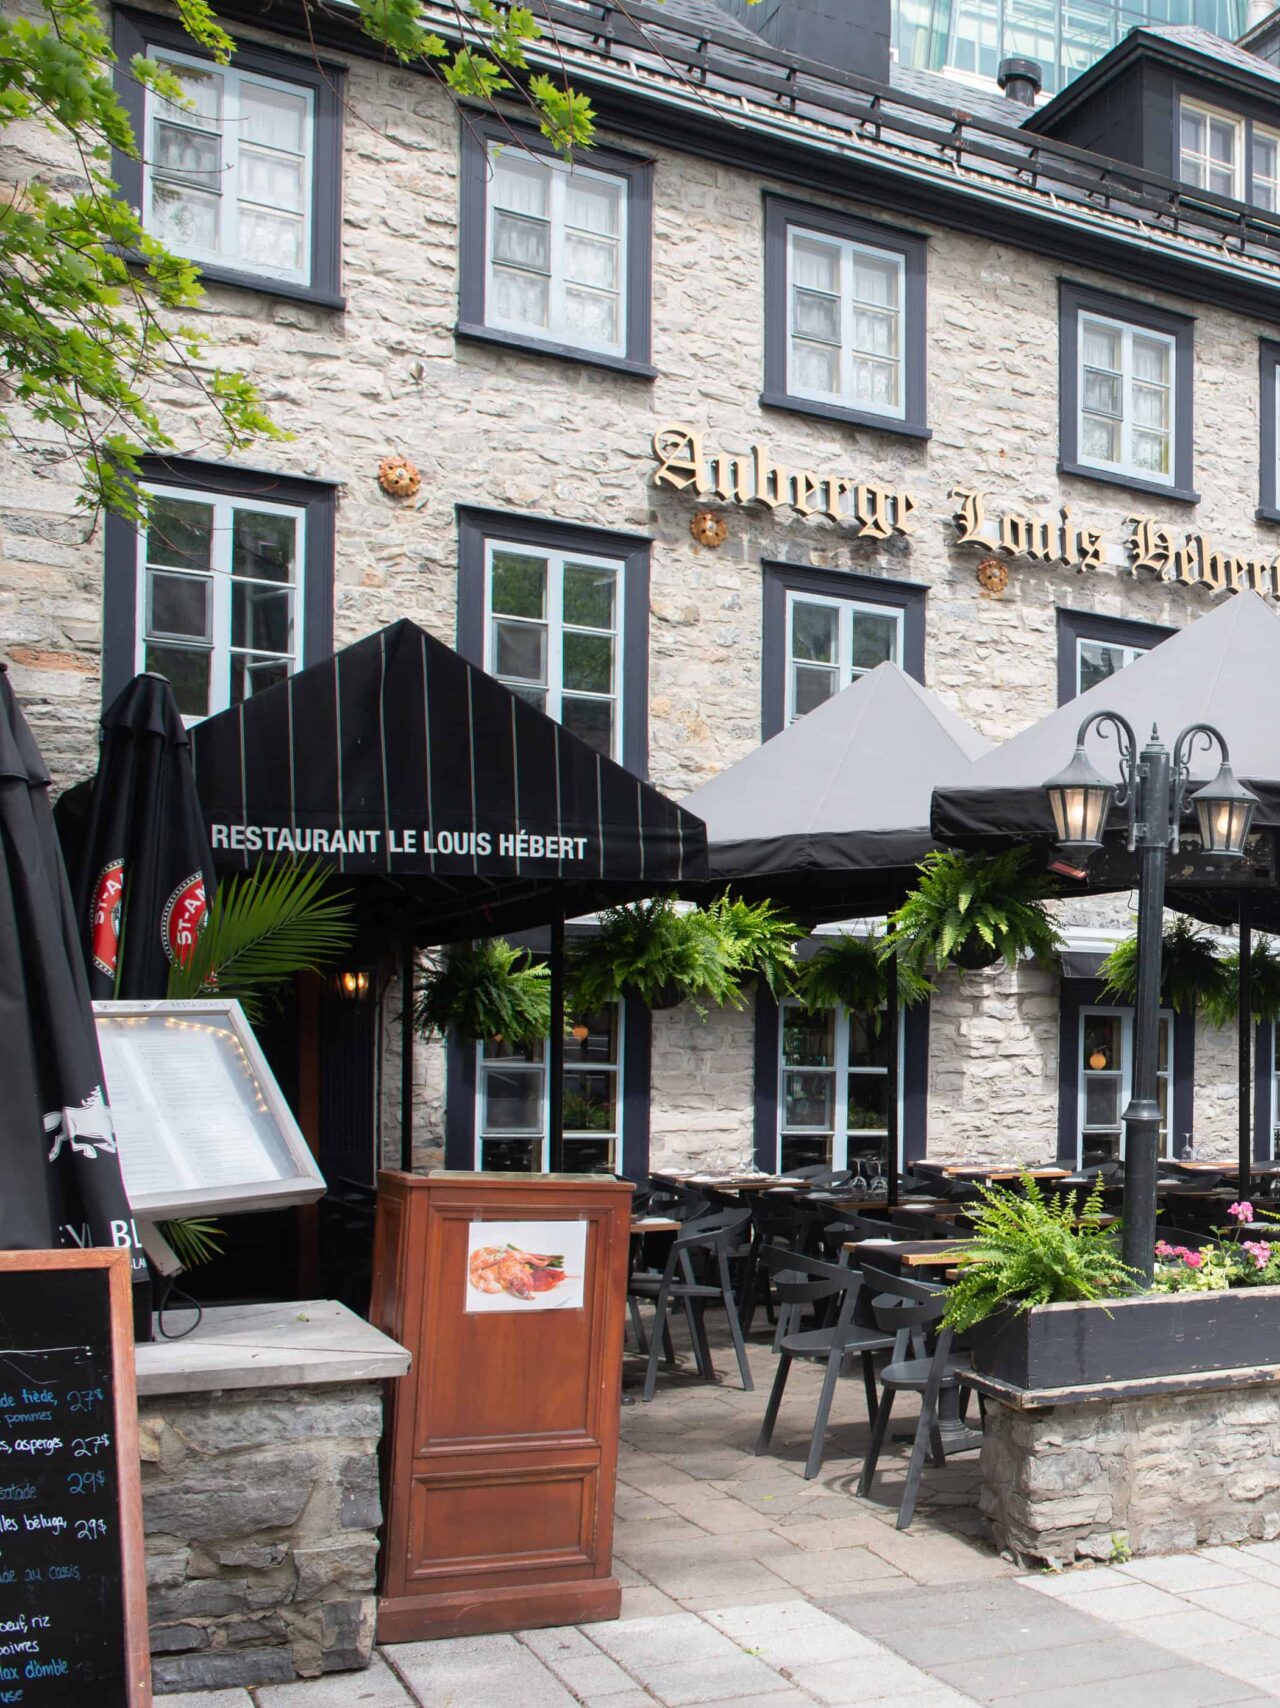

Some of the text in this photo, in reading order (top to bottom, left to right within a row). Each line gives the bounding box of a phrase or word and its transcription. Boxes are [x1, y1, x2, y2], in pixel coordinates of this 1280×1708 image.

[654, 423, 919, 540] Auberge
[948, 487, 1103, 573] Louis
[211, 824, 588, 859] RESTAURANT LE LOUIS HÉBERT
[14, 1437, 64, 1456] asperges
[66, 1469, 106, 1494] 29$
[74, 1518, 108, 1541] 29$
[31, 1614, 51, 1629] riz
